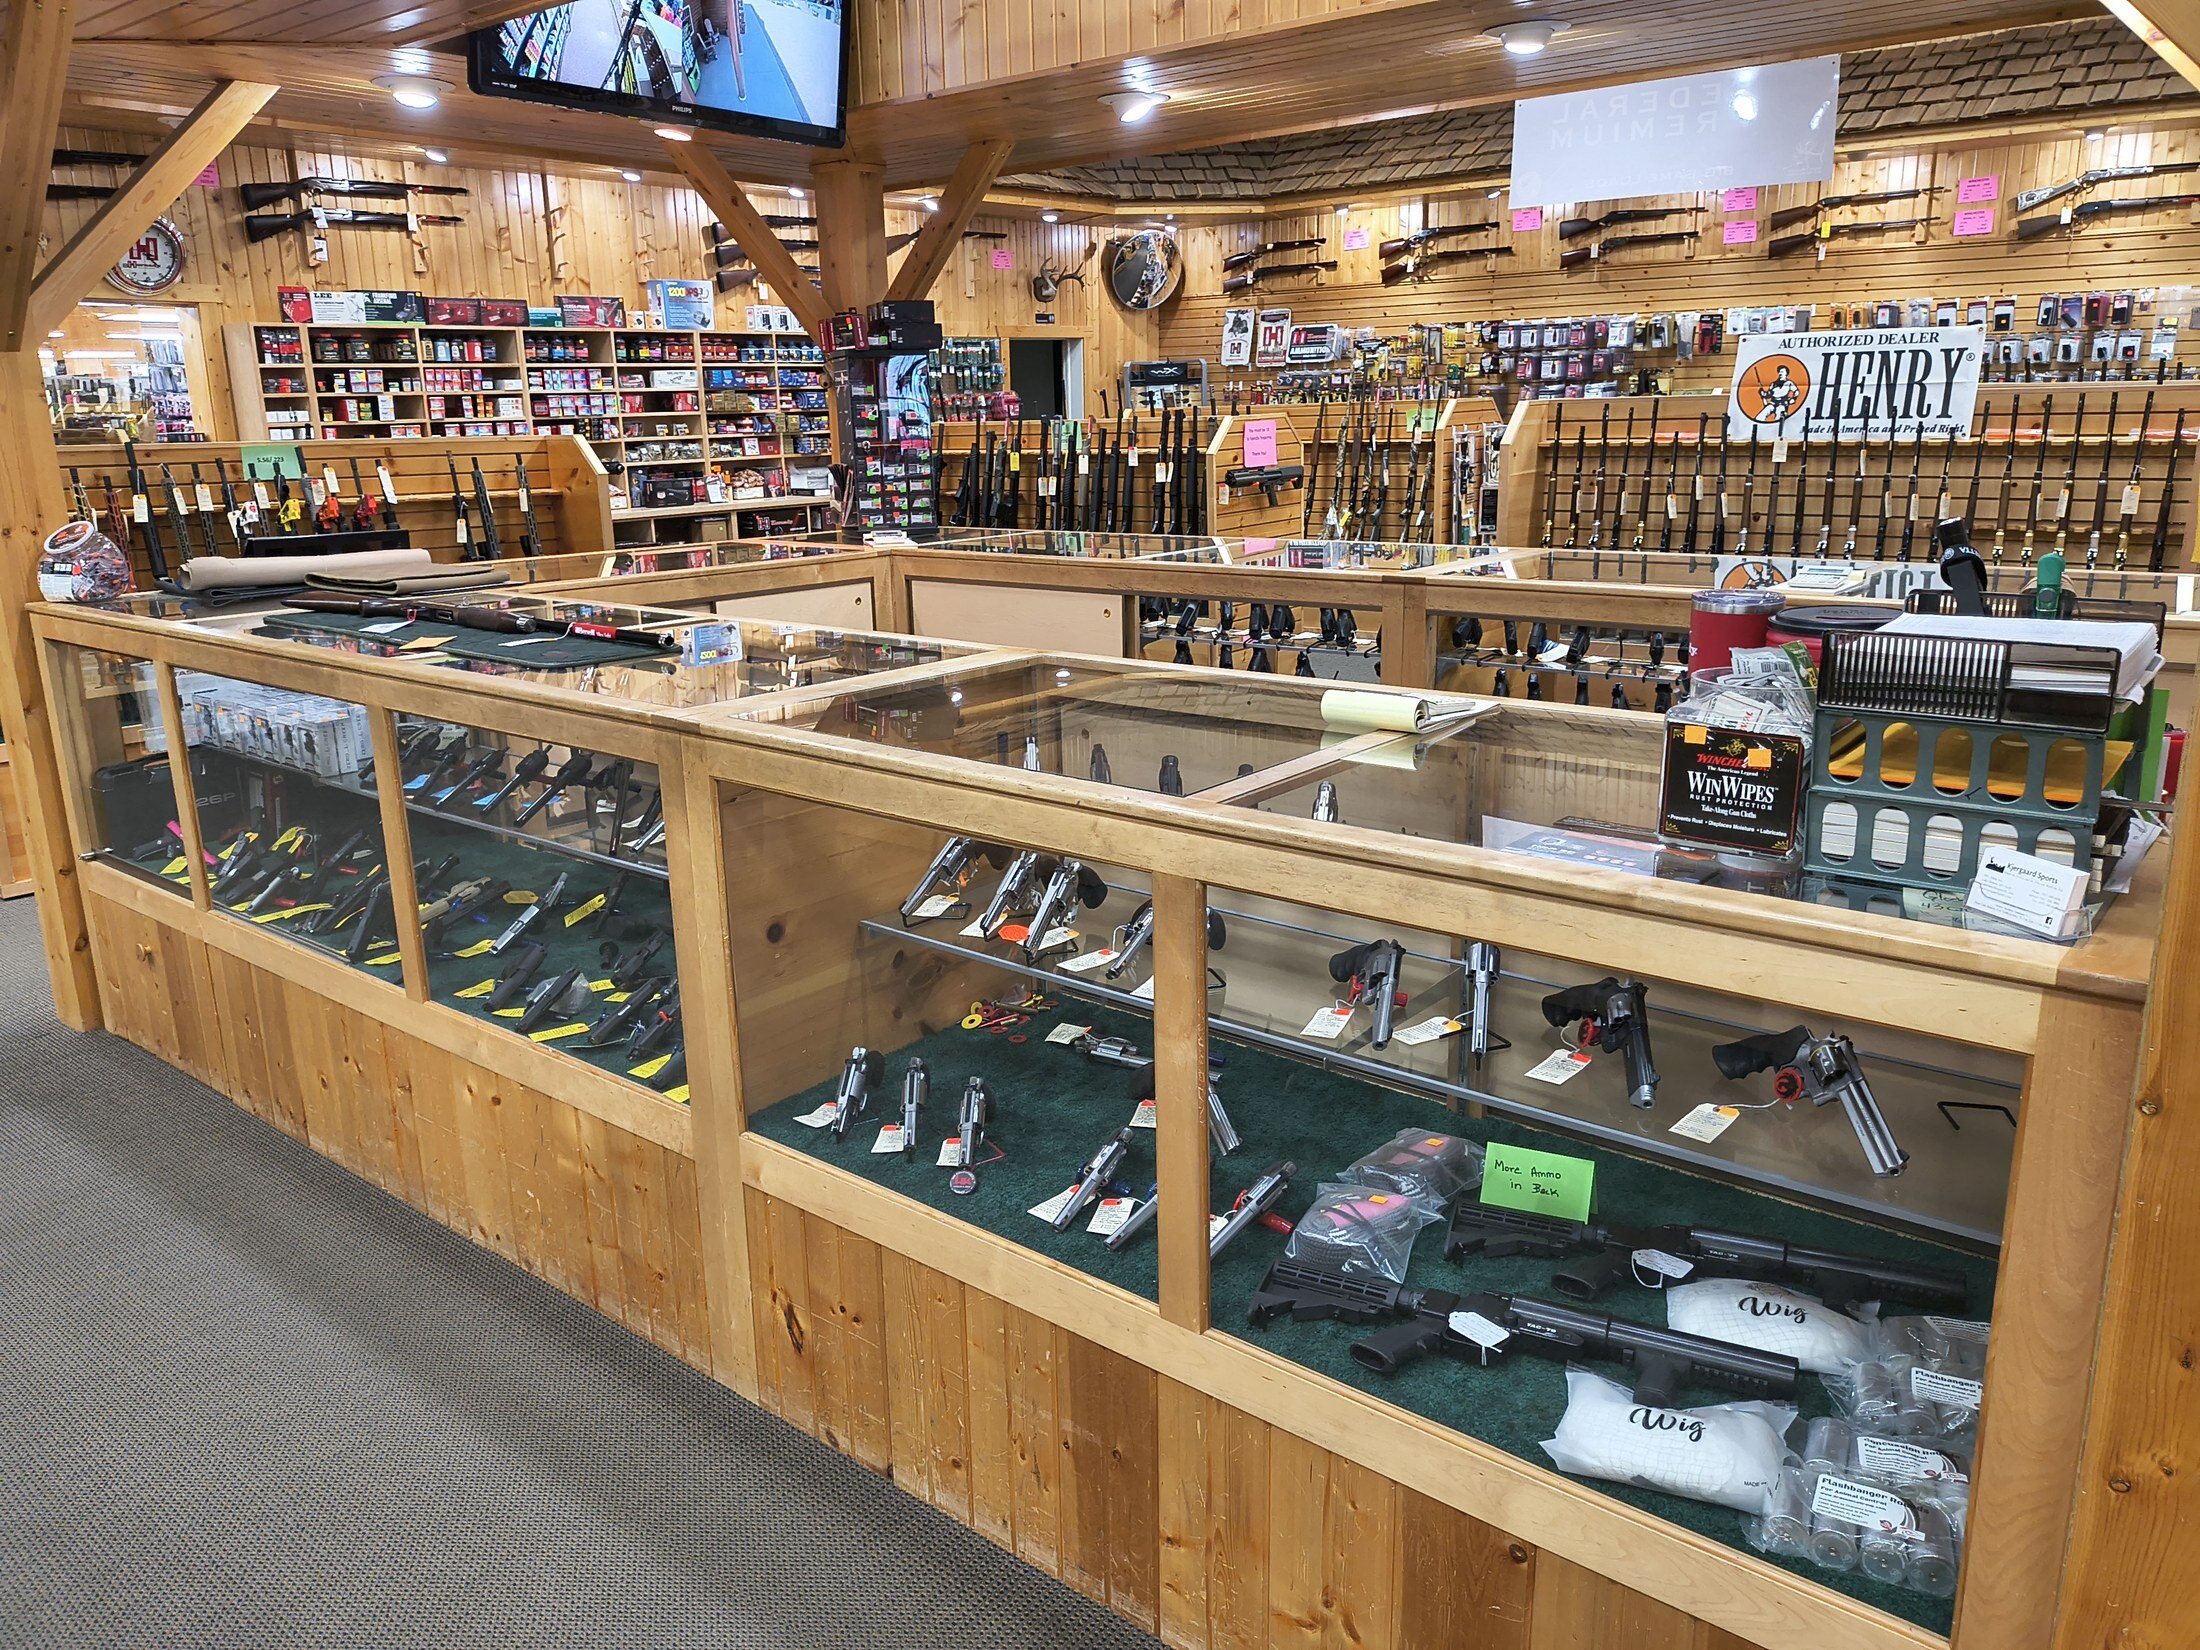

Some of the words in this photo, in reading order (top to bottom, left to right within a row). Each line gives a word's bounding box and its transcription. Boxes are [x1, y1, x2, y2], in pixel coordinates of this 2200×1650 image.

[672, 105, 693, 114] PHILIPS
[1778, 335, 1874, 350] AUTHORIZED
[1878, 332, 1940, 346] DEALER
[1811, 348, 1968, 420] HENRY
[1697, 753, 1770, 772] WINCHE
[1741, 770, 1759, 778] Legend
[1690, 794, 1712, 802] RUST
[1716, 798, 1773, 811] PROTECTION
[1702, 804, 1729, 816] Take-Along
[1728, 808, 1741, 818] Gun
[1741, 810, 1757, 819] Cloths
[1732, 824, 1755, 832] Moisture
[2006, 862, 2036, 878] Kjergaard
[2038, 872, 2058, 884] Sports
[1494, 1159, 1522, 1175] More
[1531, 1166, 1562, 1180] Ammo
[1510, 1179, 1522, 1190] in
[1532, 1183, 1560, 1198] Back
[1738, 1296, 1808, 1324] Wig
[1916, 1370, 1976, 1388] Flashbanger
[1630, 1408, 1706, 1442] Wig
[1822, 1478, 1888, 1500] Flashbanger
[1834, 1490, 1859, 1499] Animal
[1860, 1496, 1887, 1506] Control
